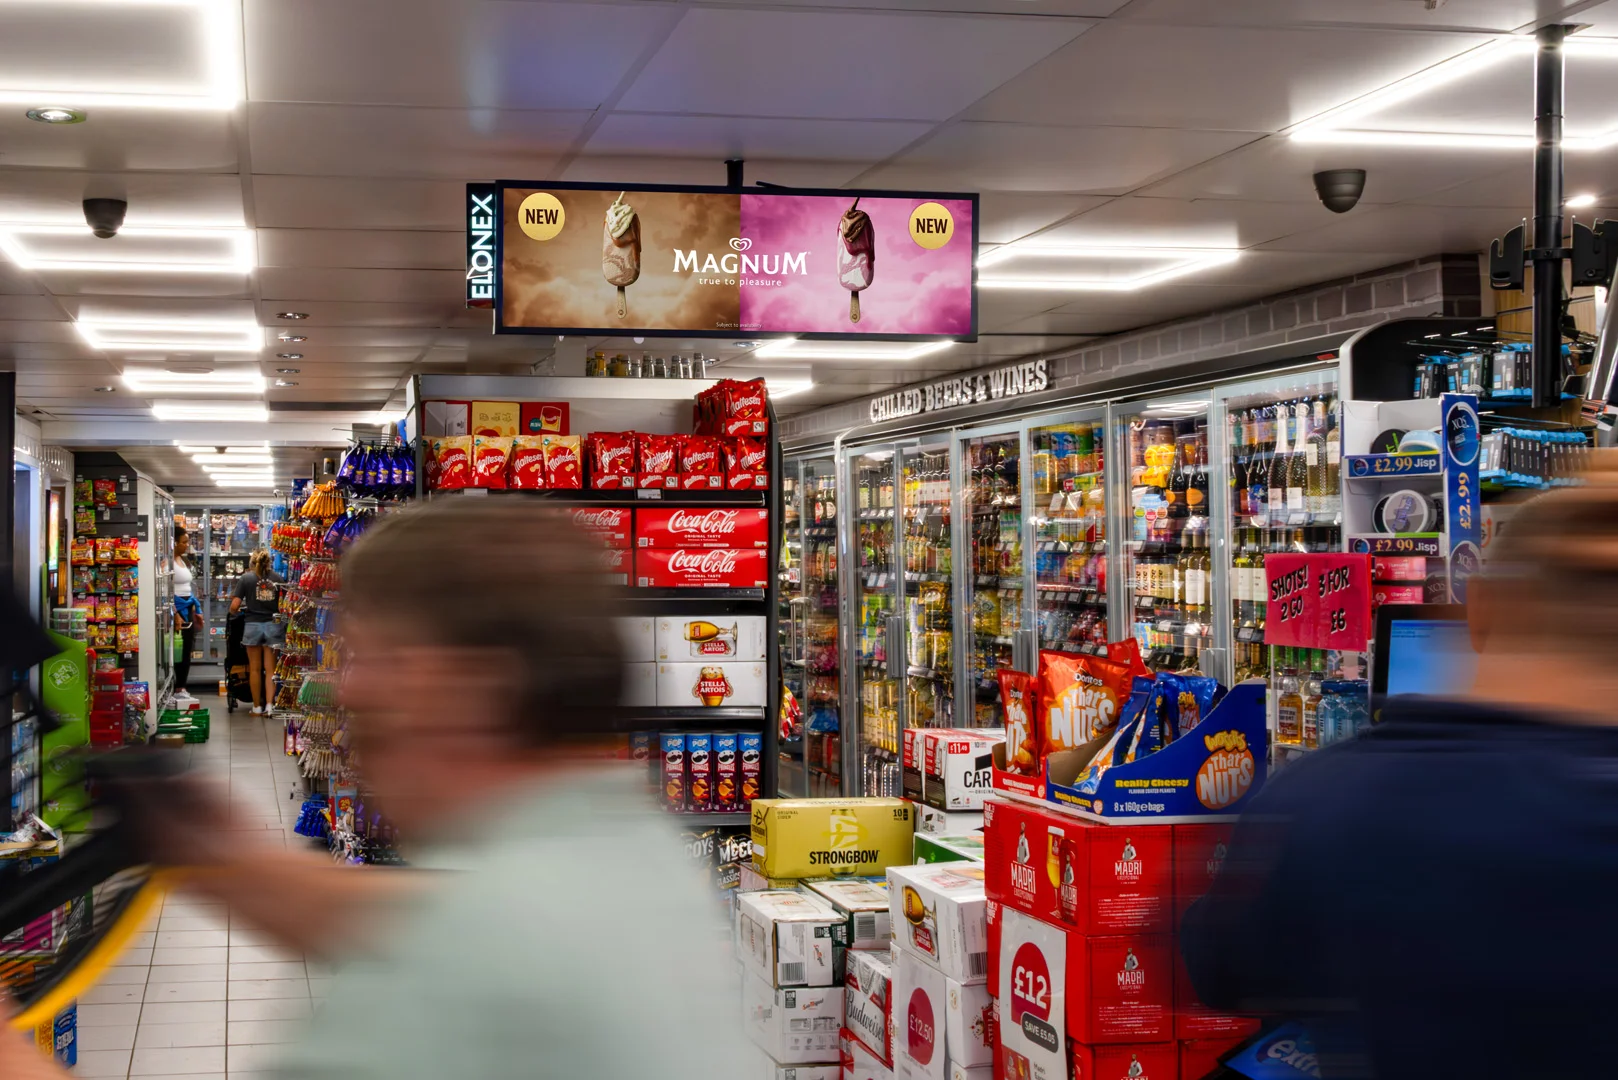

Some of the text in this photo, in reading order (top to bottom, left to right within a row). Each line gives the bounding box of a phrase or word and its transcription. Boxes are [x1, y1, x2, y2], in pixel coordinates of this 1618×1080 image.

[525, 208, 559, 225] NEW
[916, 218, 949, 234] NEW
[470, 194, 493, 299] ELONEX
[724, 278, 735, 286] to
[739, 278, 782, 287] pleasure
[869, 359, 1048, 424] CHILLED BEERS & WINES
[1374, 457, 1437, 473] £2.99 Jisp
[1458, 472, 1472, 529] £2.99
[667, 510, 740, 533] Coca-Cola
[1375, 539, 1438, 554] £2.99 Jisp
[667, 549, 740, 573] Coca-Cola
[1271, 564, 1309, 602] SHOTS!
[1318, 566, 1351, 598] 3 FOR
[1281, 595, 1304, 622] 2 GO
[1330, 607, 1347, 634] £6
[1074, 672, 1103, 687] Doritos
[1115, 779, 1189, 788] Really Cheesy
[1200, 757, 1252, 804] NUTS
[893, 809, 902, 817] 10
[1114, 802, 1119, 812] 8
[809, 850, 879, 865] STRONGBOW
[1014, 965, 1047, 1009] £12
[846, 988, 885, 1042] Budweiser
[909, 1014, 934, 1043] £12.50
[1024, 1020, 1040, 1036] SAVE
